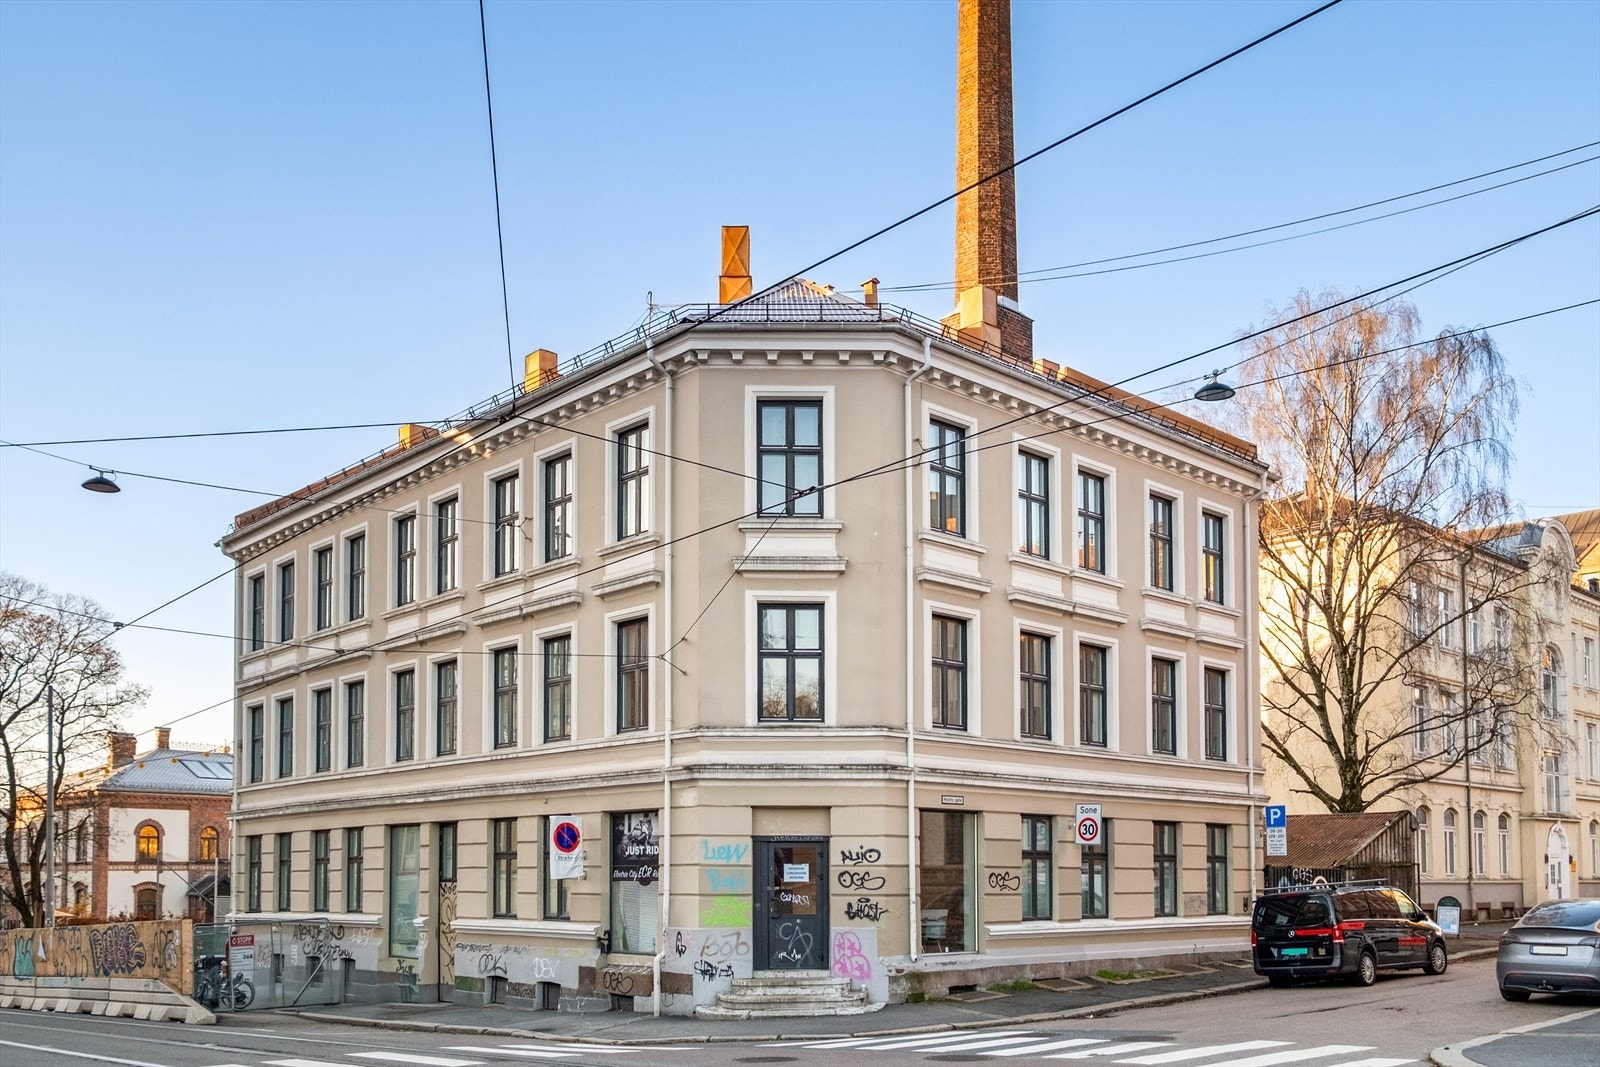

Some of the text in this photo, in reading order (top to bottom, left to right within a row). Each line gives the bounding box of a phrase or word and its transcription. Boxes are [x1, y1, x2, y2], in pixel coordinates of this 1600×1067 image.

[1079, 806, 1098, 814] Sone
[1081, 823, 1095, 836] 30
[624, 845, 644, 855] JUST
[638, 865, 652, 878] ECR
